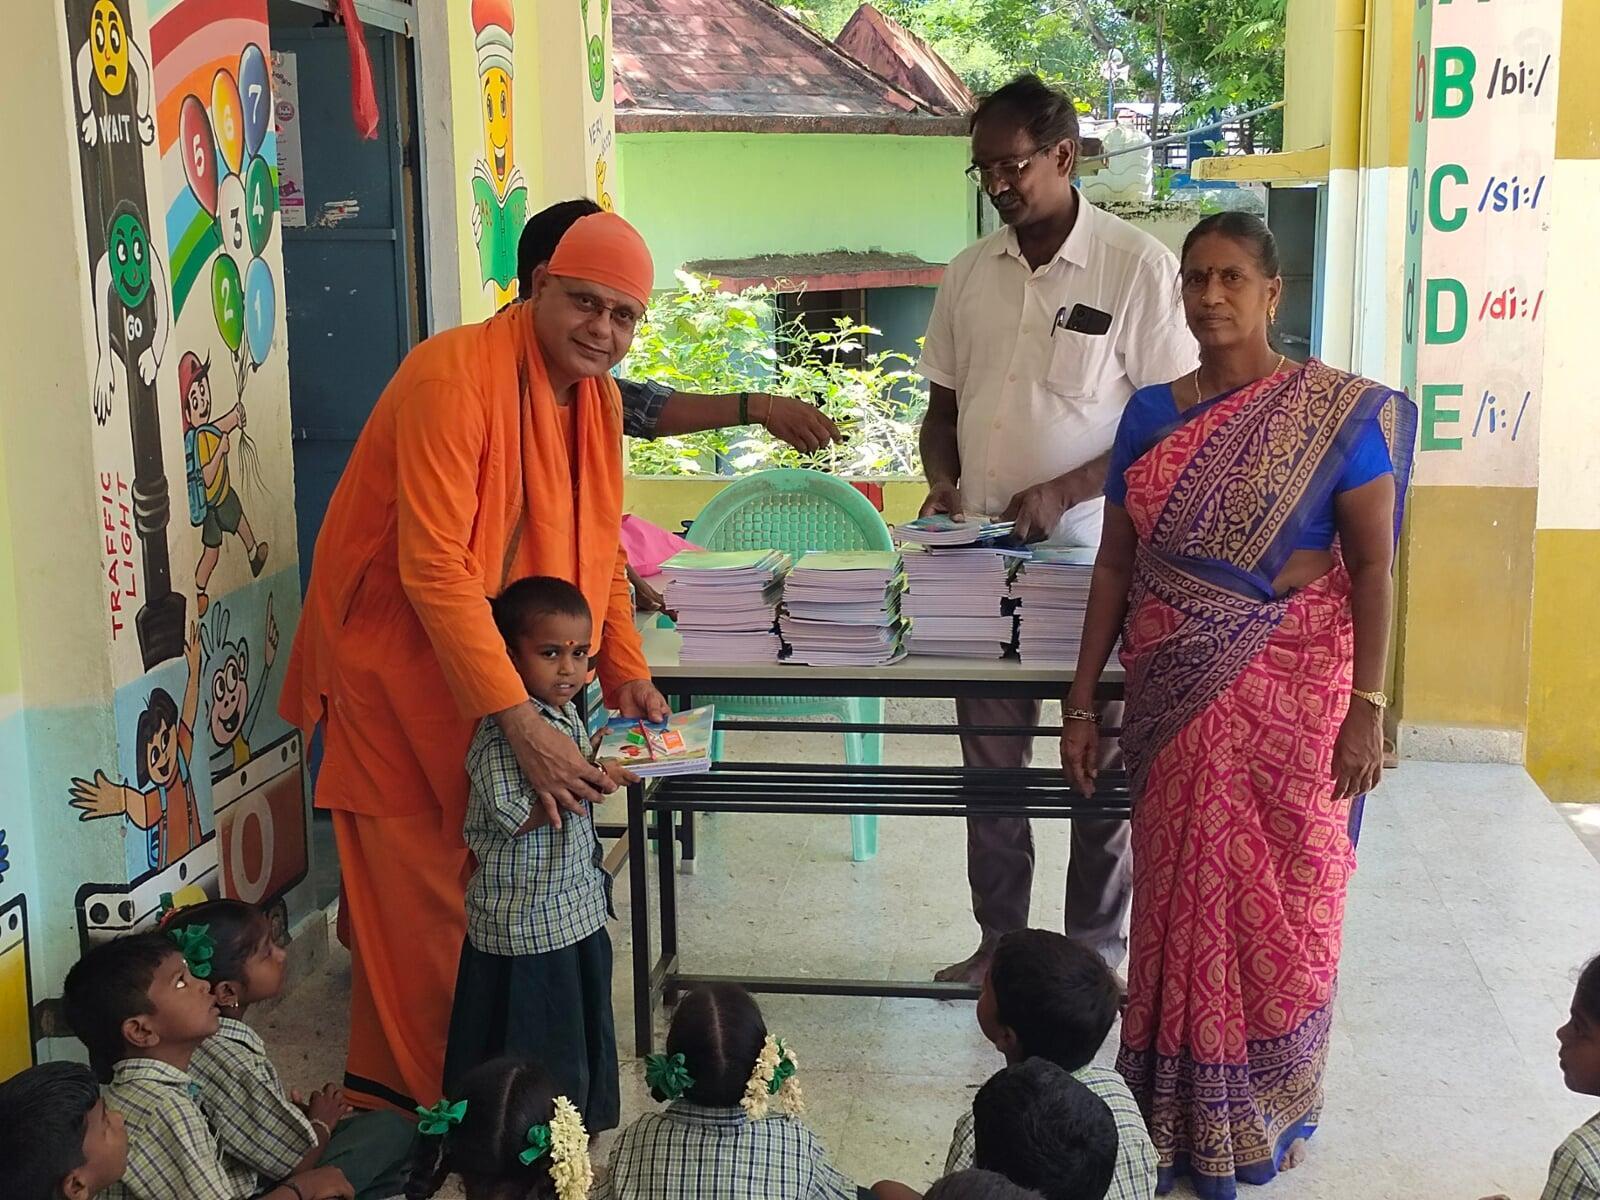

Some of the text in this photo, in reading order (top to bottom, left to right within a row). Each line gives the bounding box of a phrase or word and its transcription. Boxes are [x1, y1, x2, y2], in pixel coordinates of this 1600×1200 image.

[248, 84, 262, 124] 7
[1431, 46, 1551, 119] B /bi:/
[99, 114, 130, 144] WAIT
[223, 104, 235, 141] 6
[192, 134, 205, 177] 5
[252, 182, 264, 225] 4
[1428, 163, 1546, 232] C /si:/
[230, 207, 243, 249] 3
[221, 277, 234, 320] 2
[254, 289, 261, 331] 1
[1425, 278, 1544, 345] D /di:/
[125, 315, 142, 341] GO
[1420, 384, 1531, 452] E /i:/
[116, 471, 137, 597] LIGHT
[101, 472, 123, 641] TRAFFIC
